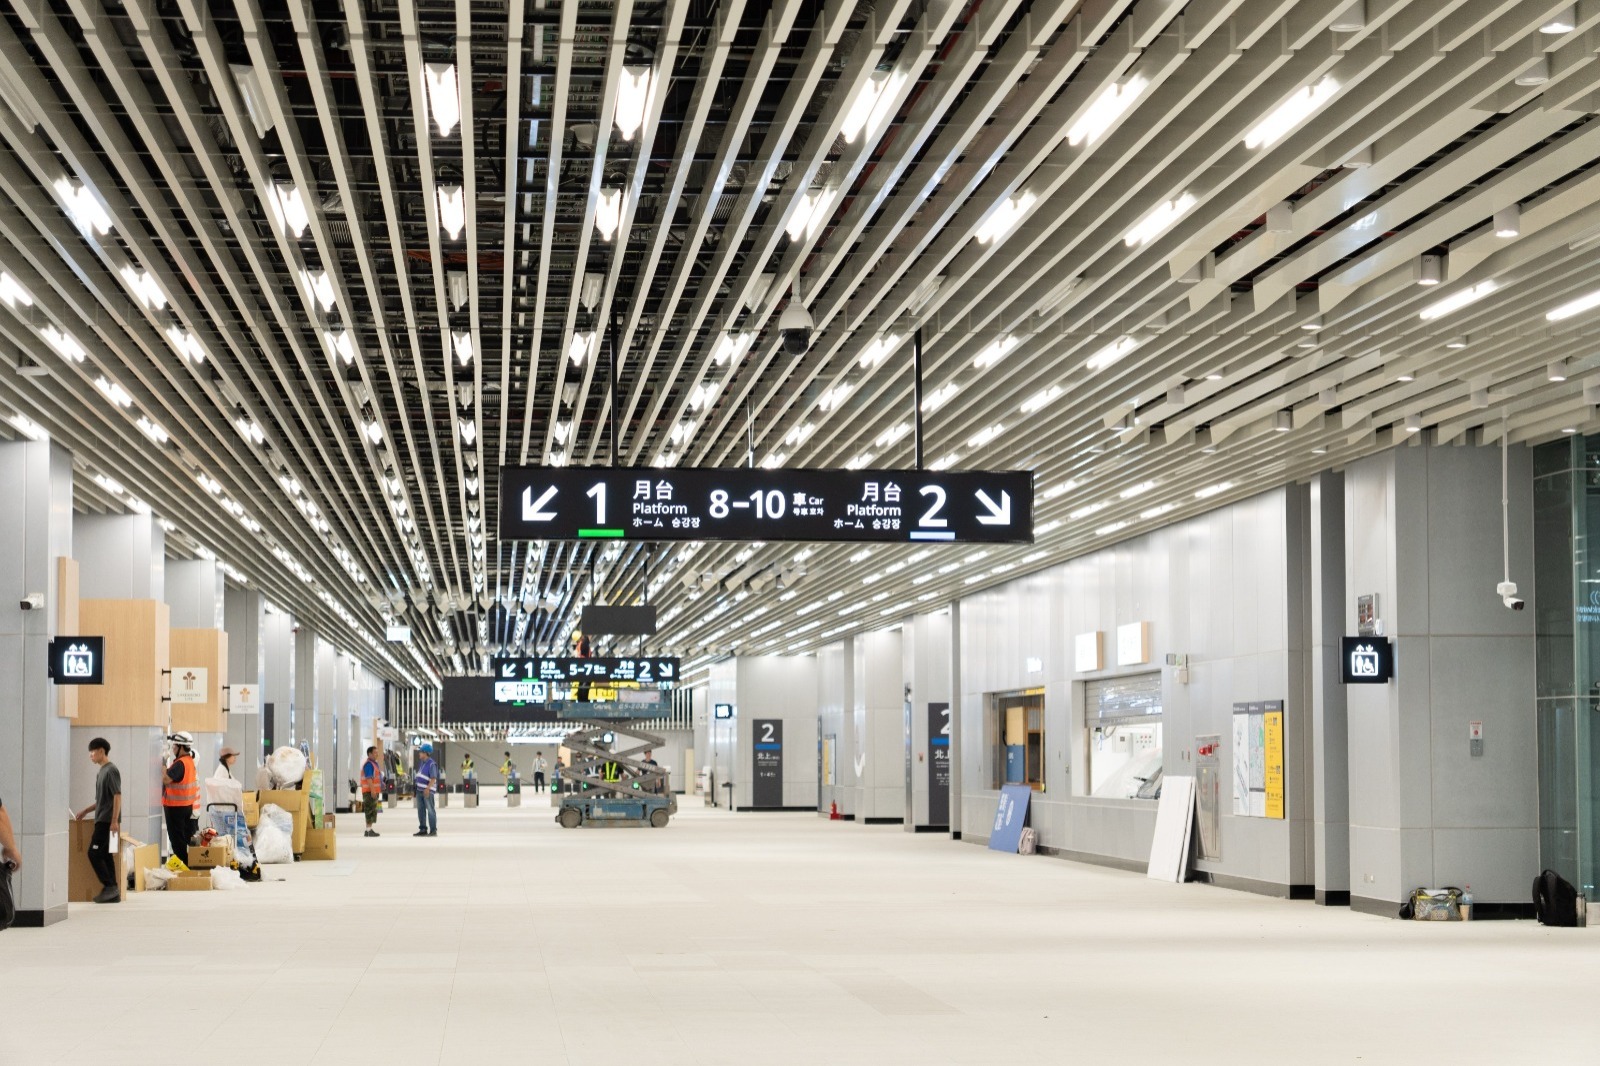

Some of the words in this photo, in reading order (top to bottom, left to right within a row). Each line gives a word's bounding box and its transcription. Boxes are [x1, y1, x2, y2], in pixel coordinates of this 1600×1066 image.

[632, 480, 673, 500] 月台
[861, 481, 902, 502] 月台
[585, 481, 607, 525] 1
[709, 489, 786, 520] 8-10
[792, 492, 807, 506] 車
[808, 496, 824, 506] Car
[918, 484, 948, 528] 2
[632, 502, 688, 515] Platform
[846, 504, 902, 517] Platform
[632, 517, 664, 528] ホーム
[671, 517, 701, 529] 승강장
[833, 518, 865, 529] ホーム
[872, 518, 902, 530] 승강장
[524, 662, 533, 678] 1
[569, 663, 593, 676] 5-7
[639, 661, 651, 677] 2
[761, 723, 775, 743] 2
